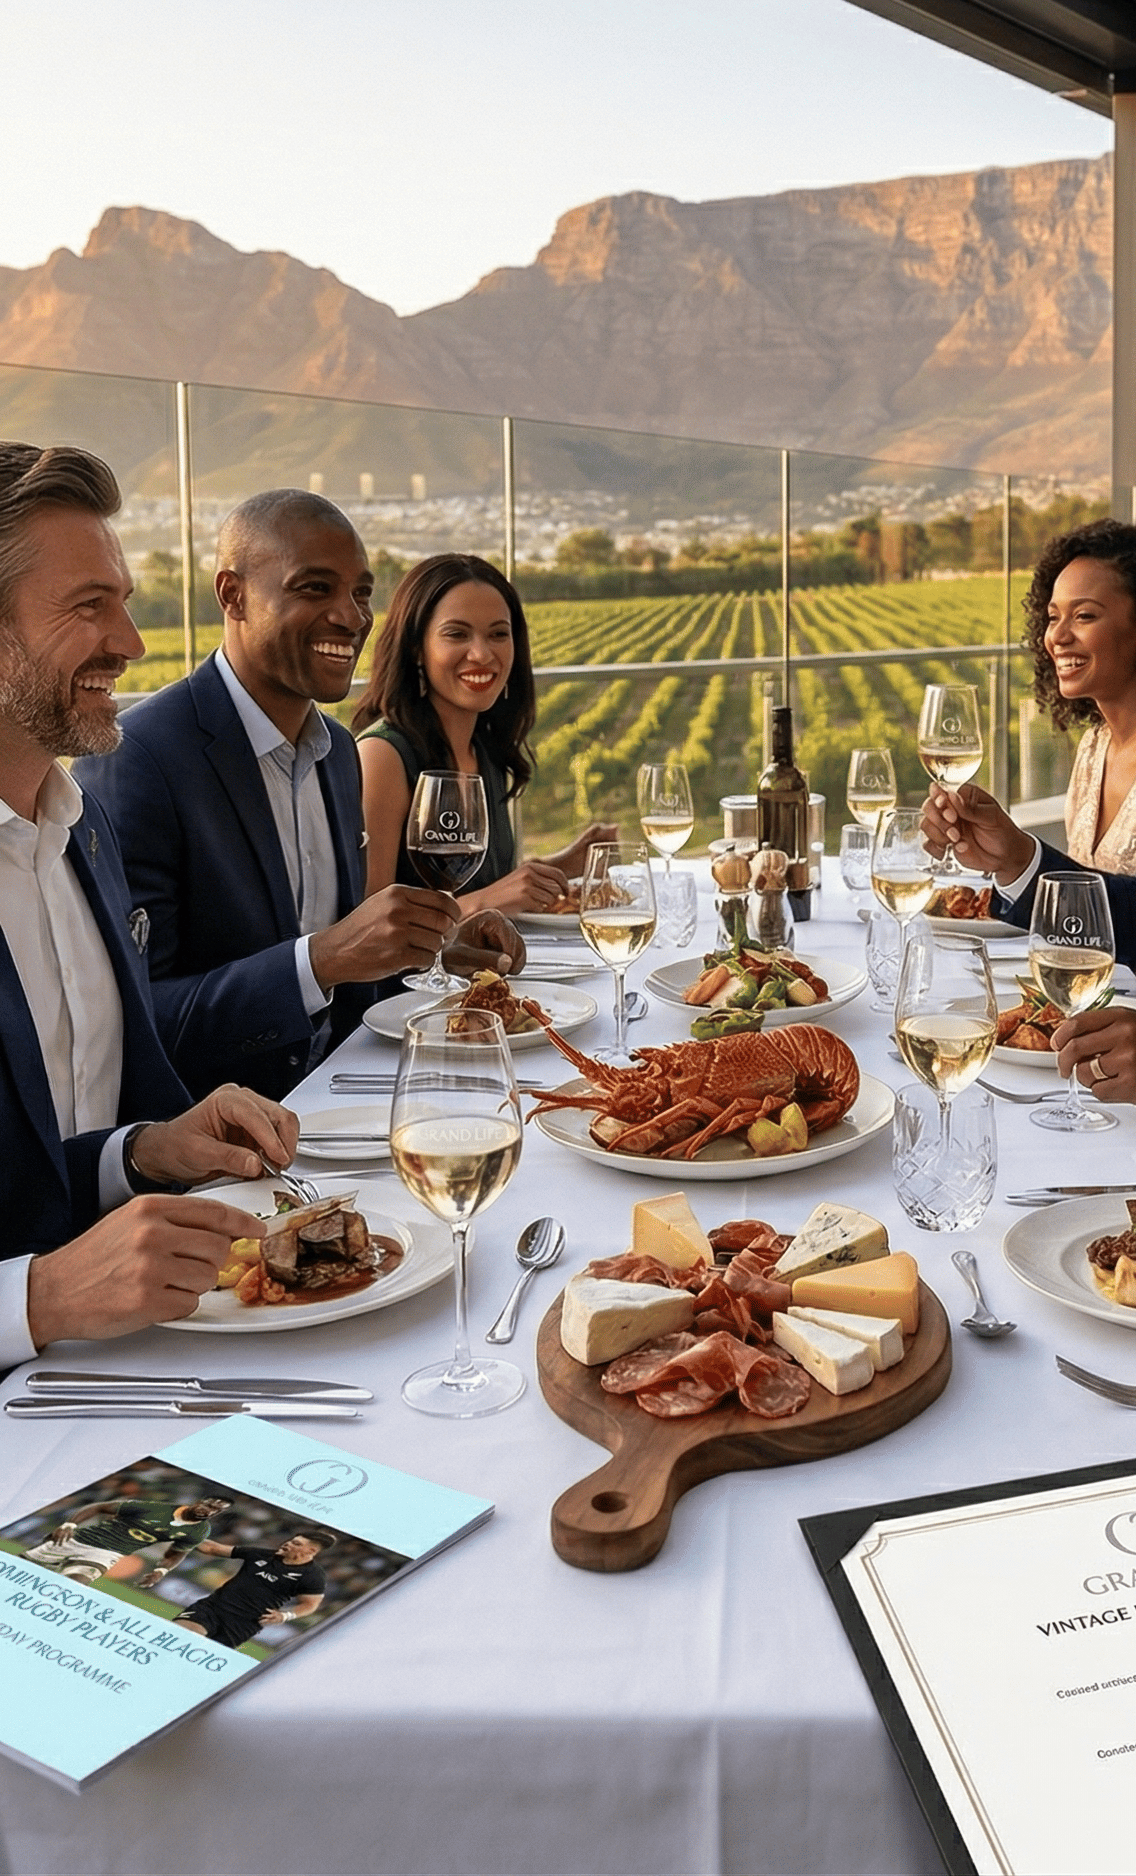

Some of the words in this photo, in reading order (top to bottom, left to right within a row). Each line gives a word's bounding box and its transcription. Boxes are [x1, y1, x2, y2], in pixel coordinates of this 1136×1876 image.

[5, 1591, 79, 1627] RUGBY
[70, 1621, 159, 1665] PLAYERS
[95, 1608, 114, 1624] &
[110, 1616, 151, 1640] ALL
[1036, 1608, 1131, 1636] VINTAGE
[26, 1639, 132, 1694] PROGRAMME
